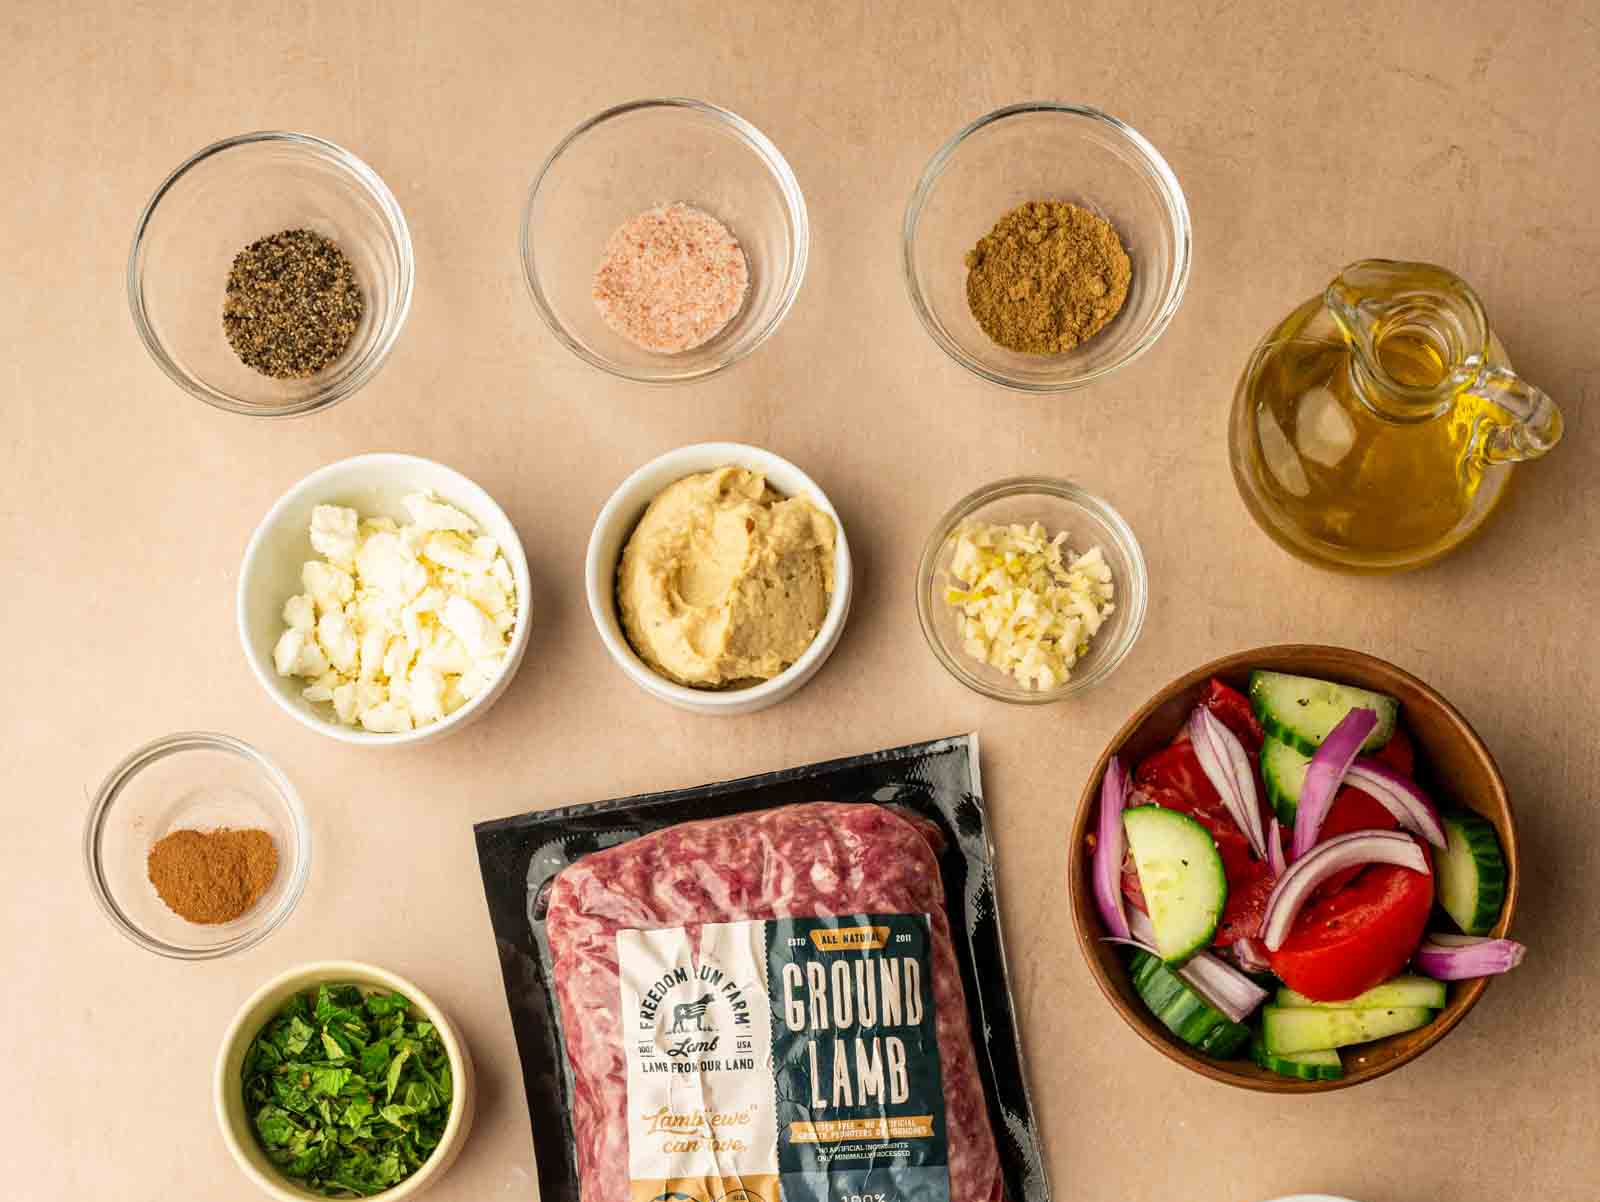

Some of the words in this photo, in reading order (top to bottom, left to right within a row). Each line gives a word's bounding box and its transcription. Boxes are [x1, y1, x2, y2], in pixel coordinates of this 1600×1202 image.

[821, 935, 838, 945] ALL
[896, 934, 911, 943] 2011
[639, 967, 688, 1030] FREEDOM
[783, 957, 923, 1031] GROUND
[667, 1035, 720, 1058] Lamb
[737, 1041, 752, 1049] USA
[642, 1062, 669, 1073] LAMB
[700, 1060, 721, 1072] OUR
[726, 1058, 754, 1070] LAND
[808, 1037, 909, 1109] LAMB
